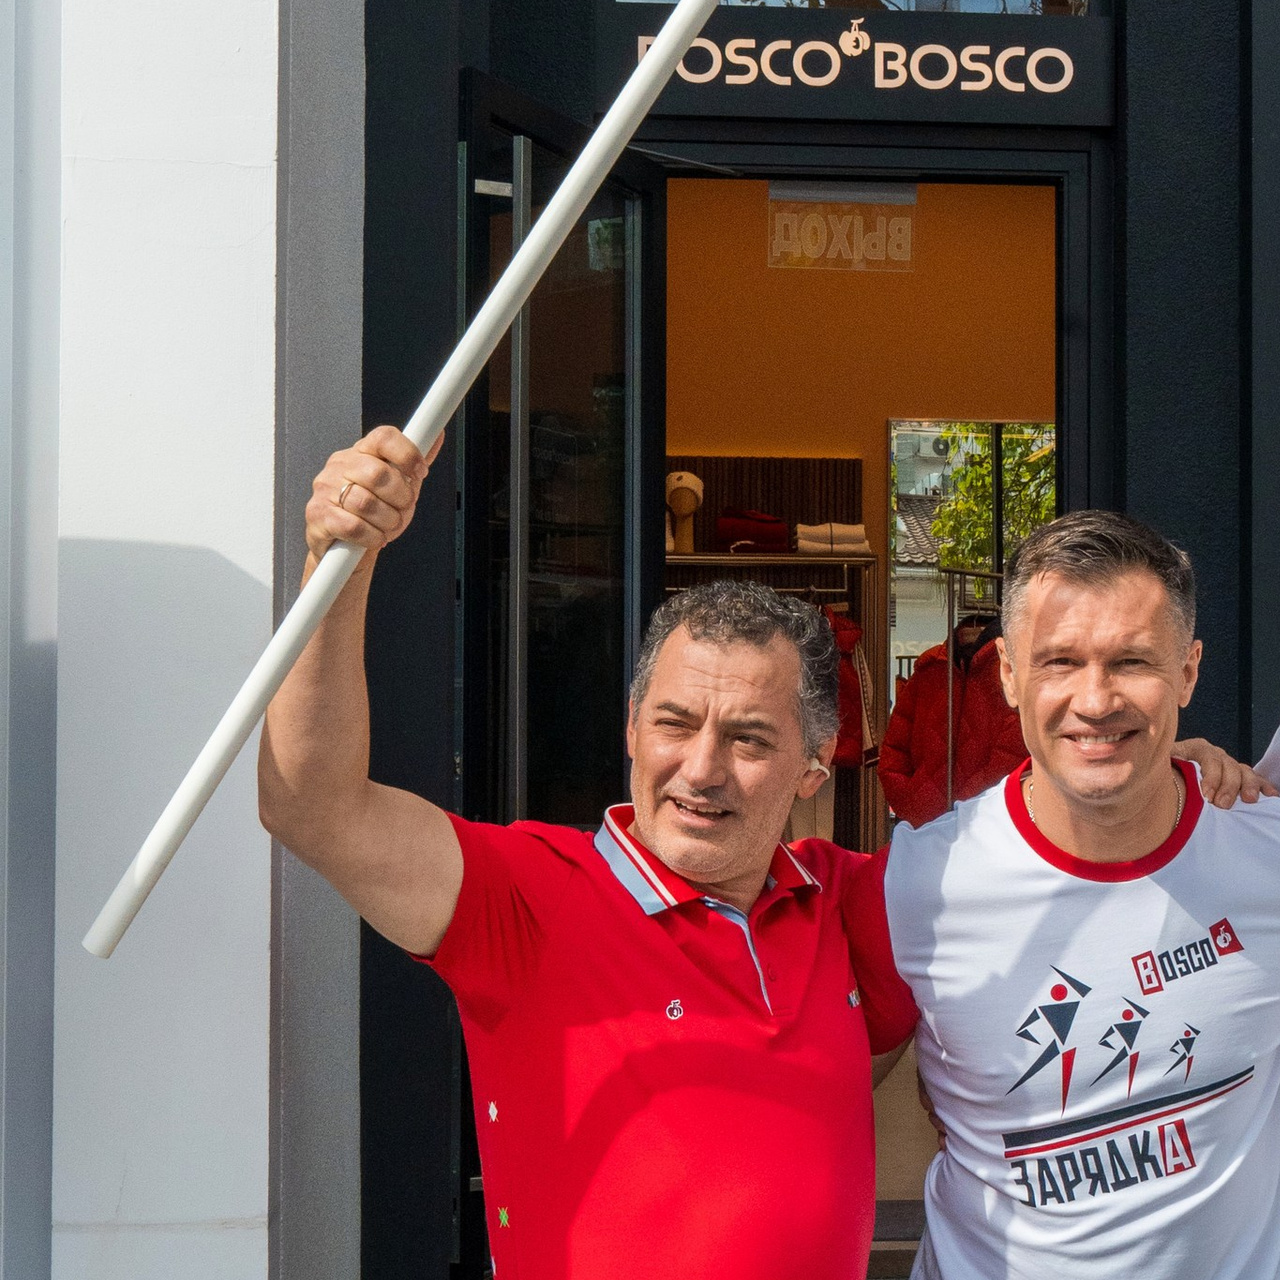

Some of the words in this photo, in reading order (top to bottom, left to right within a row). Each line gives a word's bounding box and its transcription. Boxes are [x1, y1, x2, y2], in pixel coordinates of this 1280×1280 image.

[637, 35, 842, 87] OSCO
[873, 42, 1075, 94] BOSCO
[1131, 937, 1219, 996] BOSCO
[1010, 1118, 1197, 1208] ЗАРЯДКА
